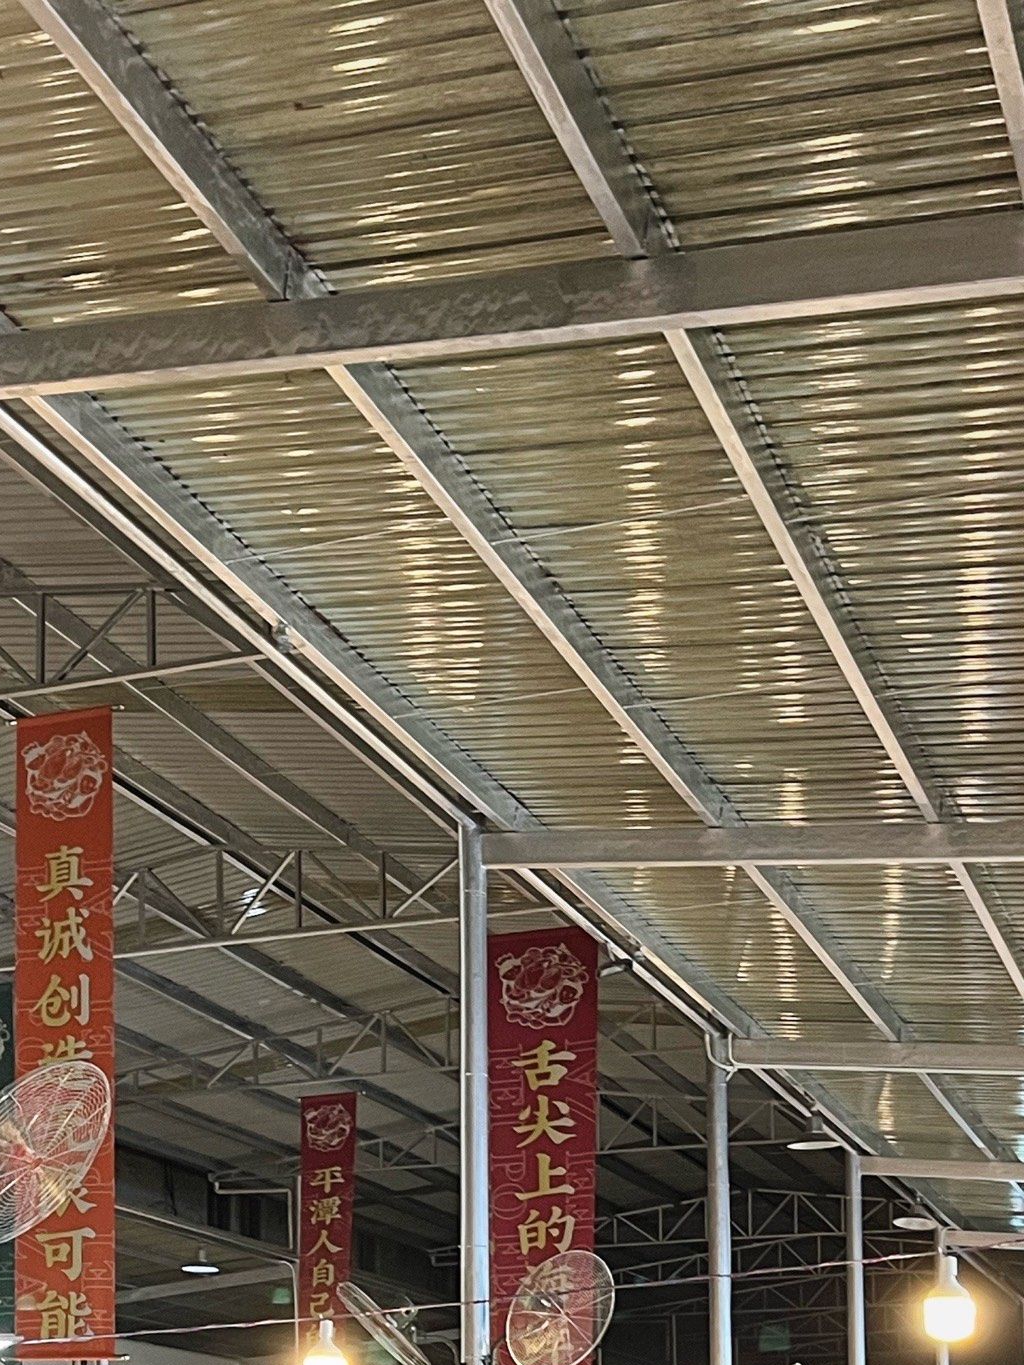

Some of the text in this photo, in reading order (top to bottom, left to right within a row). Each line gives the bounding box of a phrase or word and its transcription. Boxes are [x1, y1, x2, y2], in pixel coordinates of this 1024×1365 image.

[34, 845, 99, 1340] 真诚创造可能
